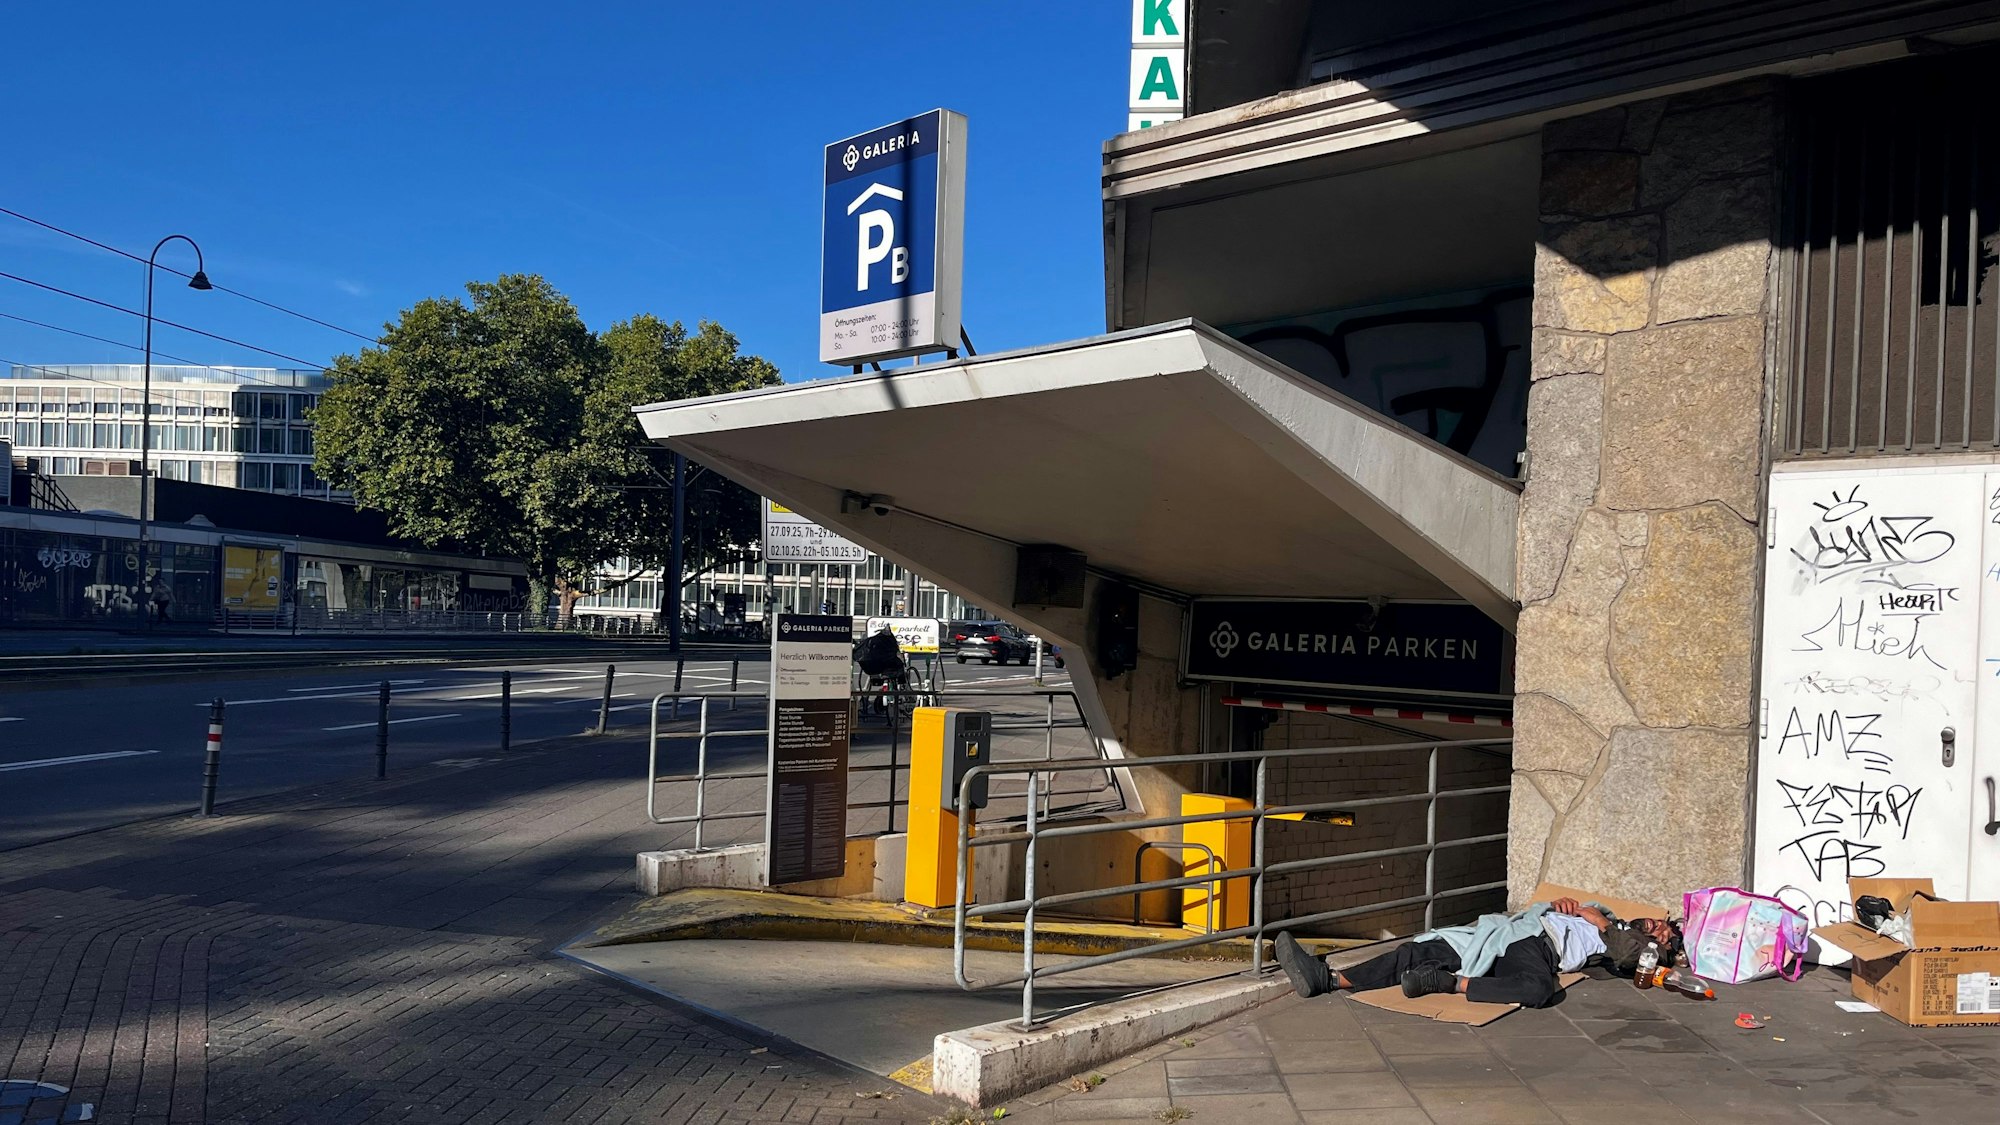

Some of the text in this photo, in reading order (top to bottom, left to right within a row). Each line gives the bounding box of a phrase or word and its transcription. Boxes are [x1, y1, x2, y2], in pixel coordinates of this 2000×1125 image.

[863, 131, 920, 160] GALERIA
[857, 209, 910, 292] P B
[834, 314, 877, 328] Öffnungszeiten:
[834, 332, 844, 340] Mo.
[871, 323, 887, 333] 07:00
[892, 320, 908, 330] 24:00
[909, 318, 919, 327] Uhr
[872, 334, 887, 343] 10:00
[892, 331, 908, 340] 24:00
[908, 329, 919, 337] Uhr
[852, 547, 861, 557] 5h
[1247, 631, 1478, 660] GALERIA PARKEN
